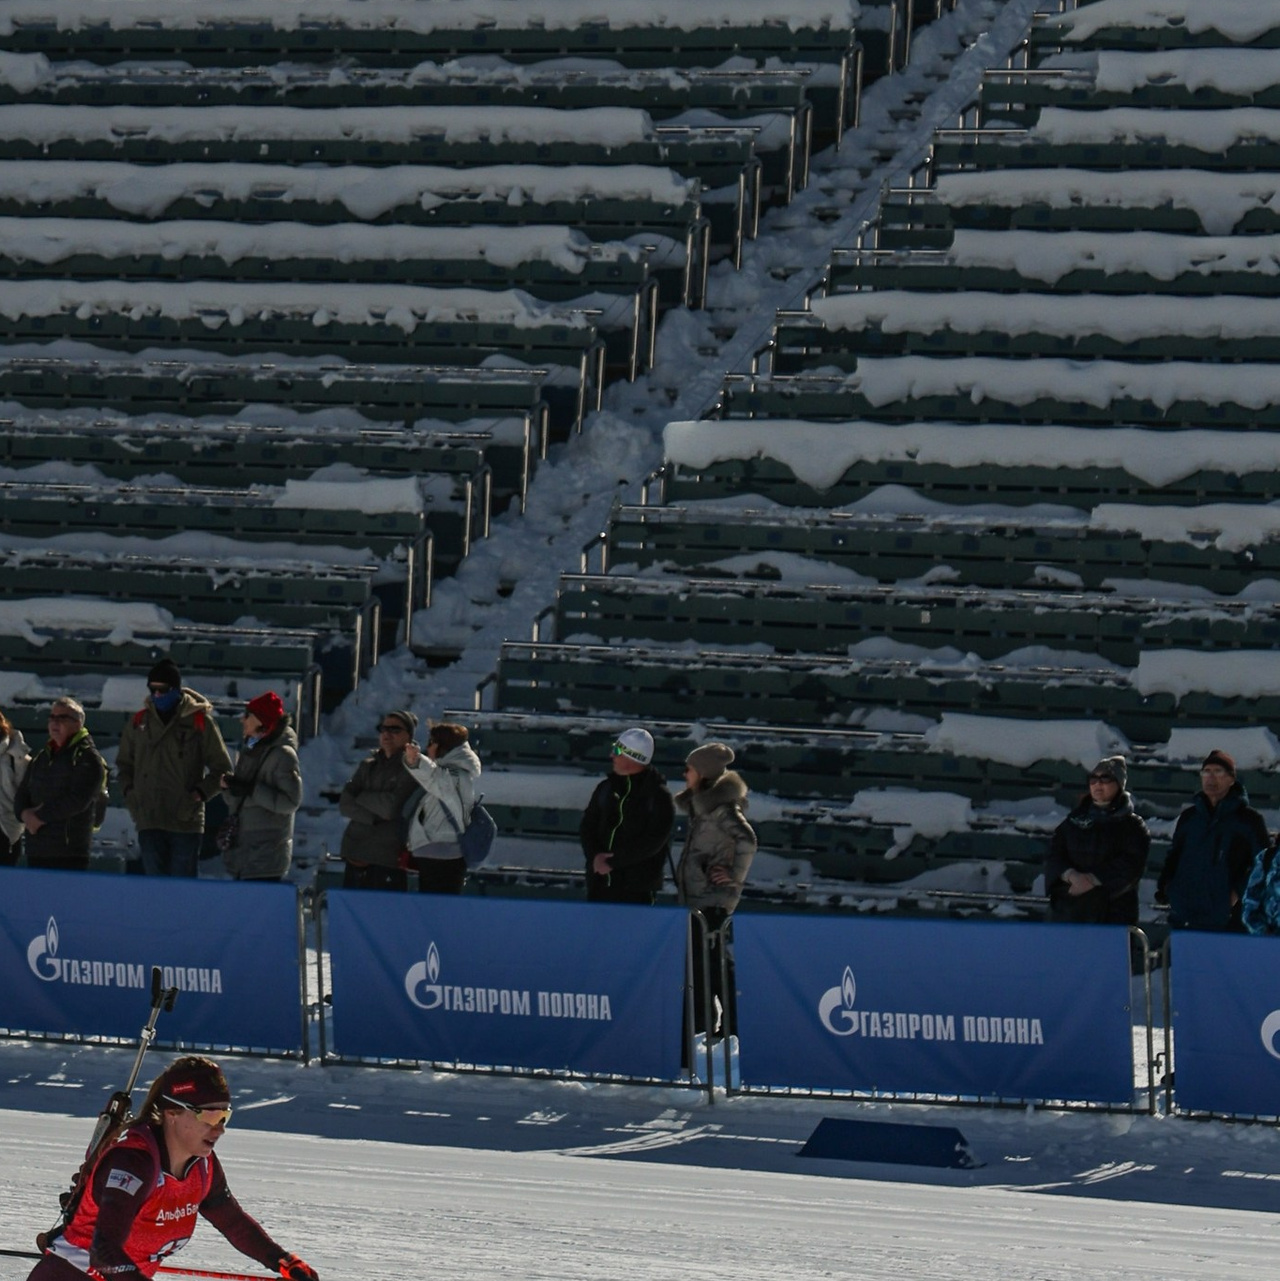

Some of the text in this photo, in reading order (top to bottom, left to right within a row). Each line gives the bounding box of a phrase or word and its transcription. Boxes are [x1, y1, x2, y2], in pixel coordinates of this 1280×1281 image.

[62, 959, 145, 989] ГАЗПРОМ
[444, 986, 612, 1020] ГАЗПРОМ ПОЛЯНА
[860, 1011, 1044, 1045] ГАЗПРОМ ПОЛЯНА
[156, 1207, 185, 1222] Альфа
